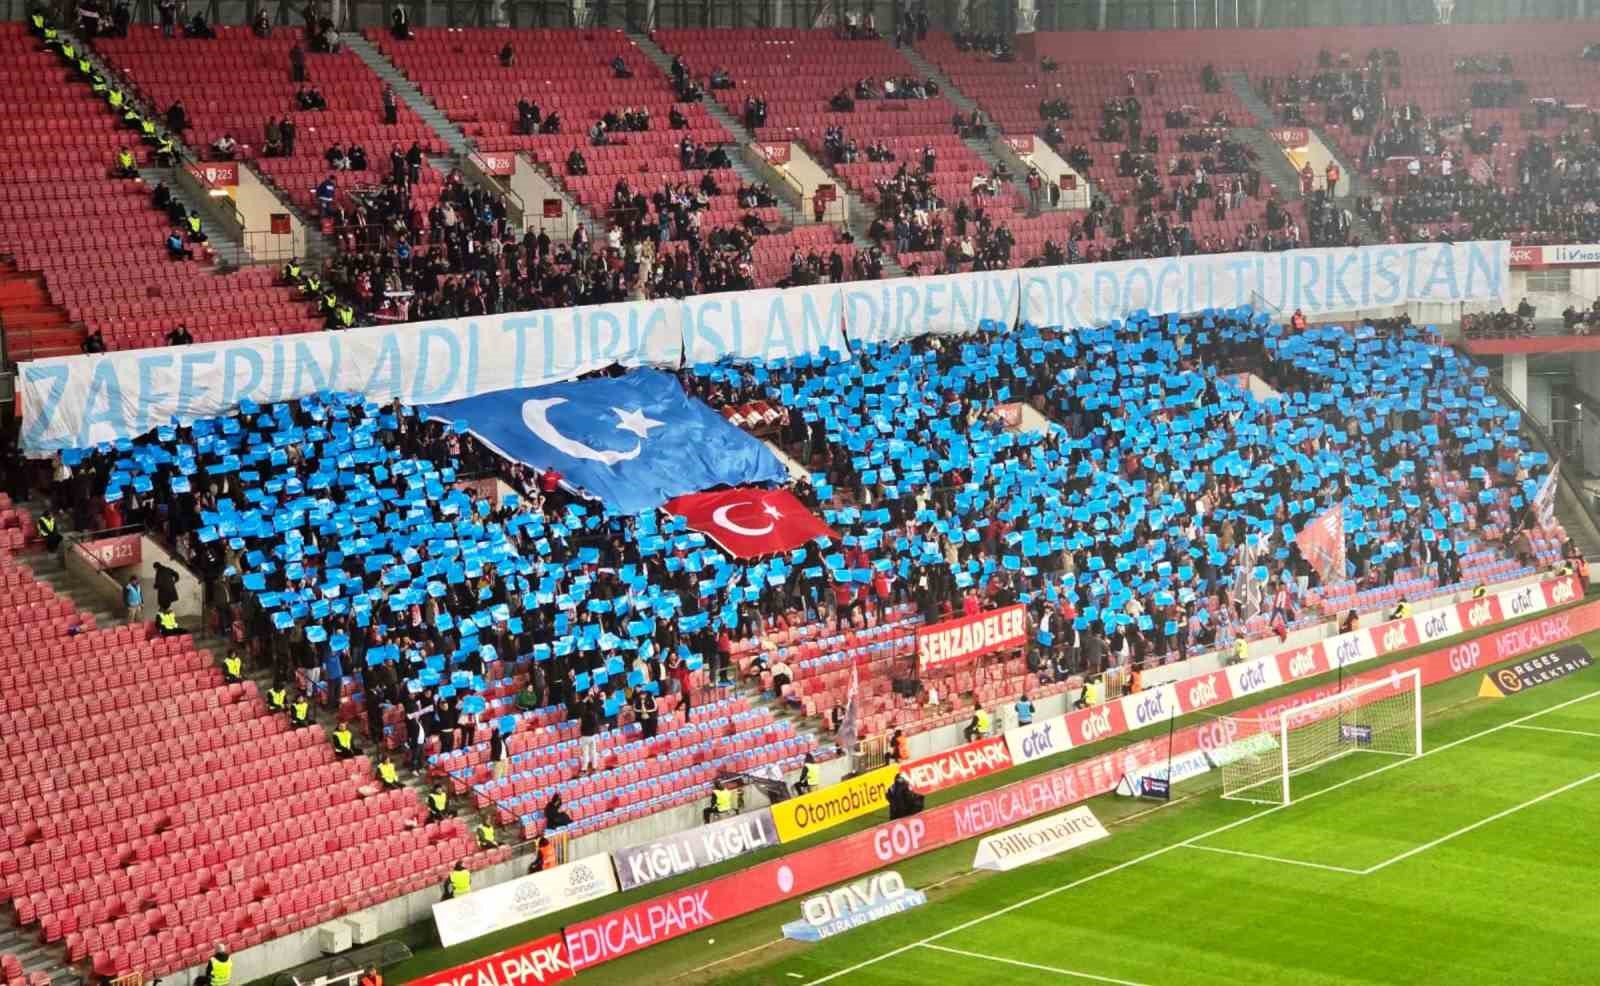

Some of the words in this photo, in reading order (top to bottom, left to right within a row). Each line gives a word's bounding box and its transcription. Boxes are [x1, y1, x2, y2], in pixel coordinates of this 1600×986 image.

[216, 169, 233, 180] 225
[114, 543, 133, 558] 121
[1449, 641, 1480, 673] GOP
[1496, 615, 1571, 658] MEDICALPARK
[1198, 718, 1237, 750] GOP
[901, 741, 1010, 791] MEDICALPARK
[794, 782, 887, 829] Otomobilen
[874, 818, 926, 861] GOP
[953, 772, 1078, 837] MEDICALPARK
[988, 813, 1097, 860] Billionaire
[803, 871, 905, 926] onvo
[565, 889, 714, 968] EDICALPARK
